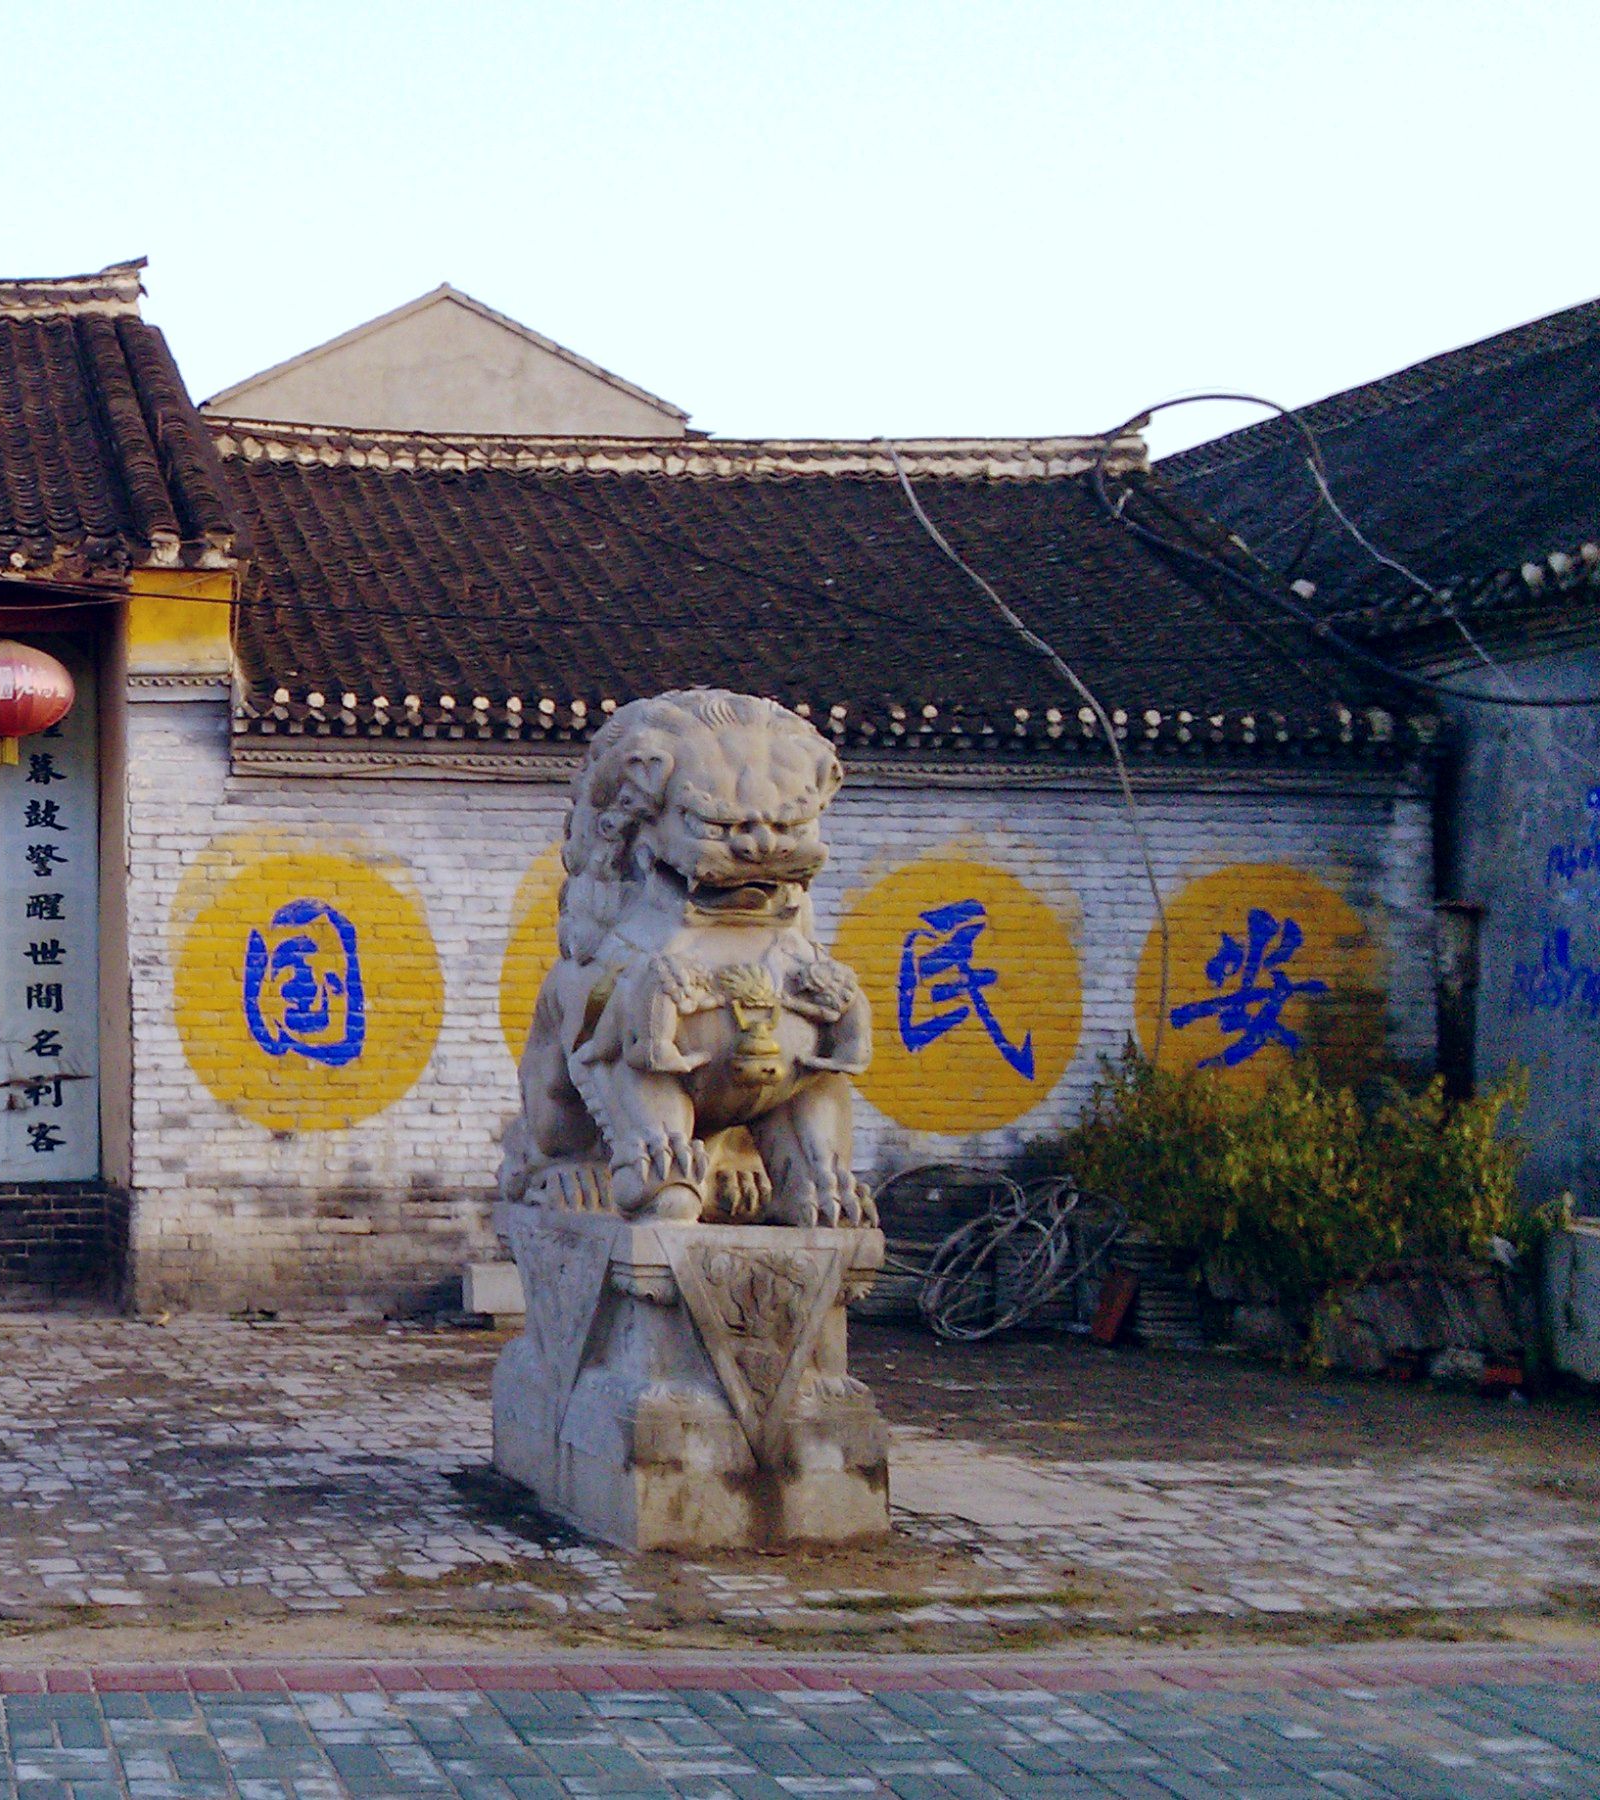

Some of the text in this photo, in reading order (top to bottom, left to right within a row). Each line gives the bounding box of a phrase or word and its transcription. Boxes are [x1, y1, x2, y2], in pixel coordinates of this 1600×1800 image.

[24, 716, 69, 1153] 暮鼓警醒世間名利客
[243, 897, 366, 1067] 国
[898, 899, 1036, 1082] 民
[1169, 907, 1331, 1069] 安
